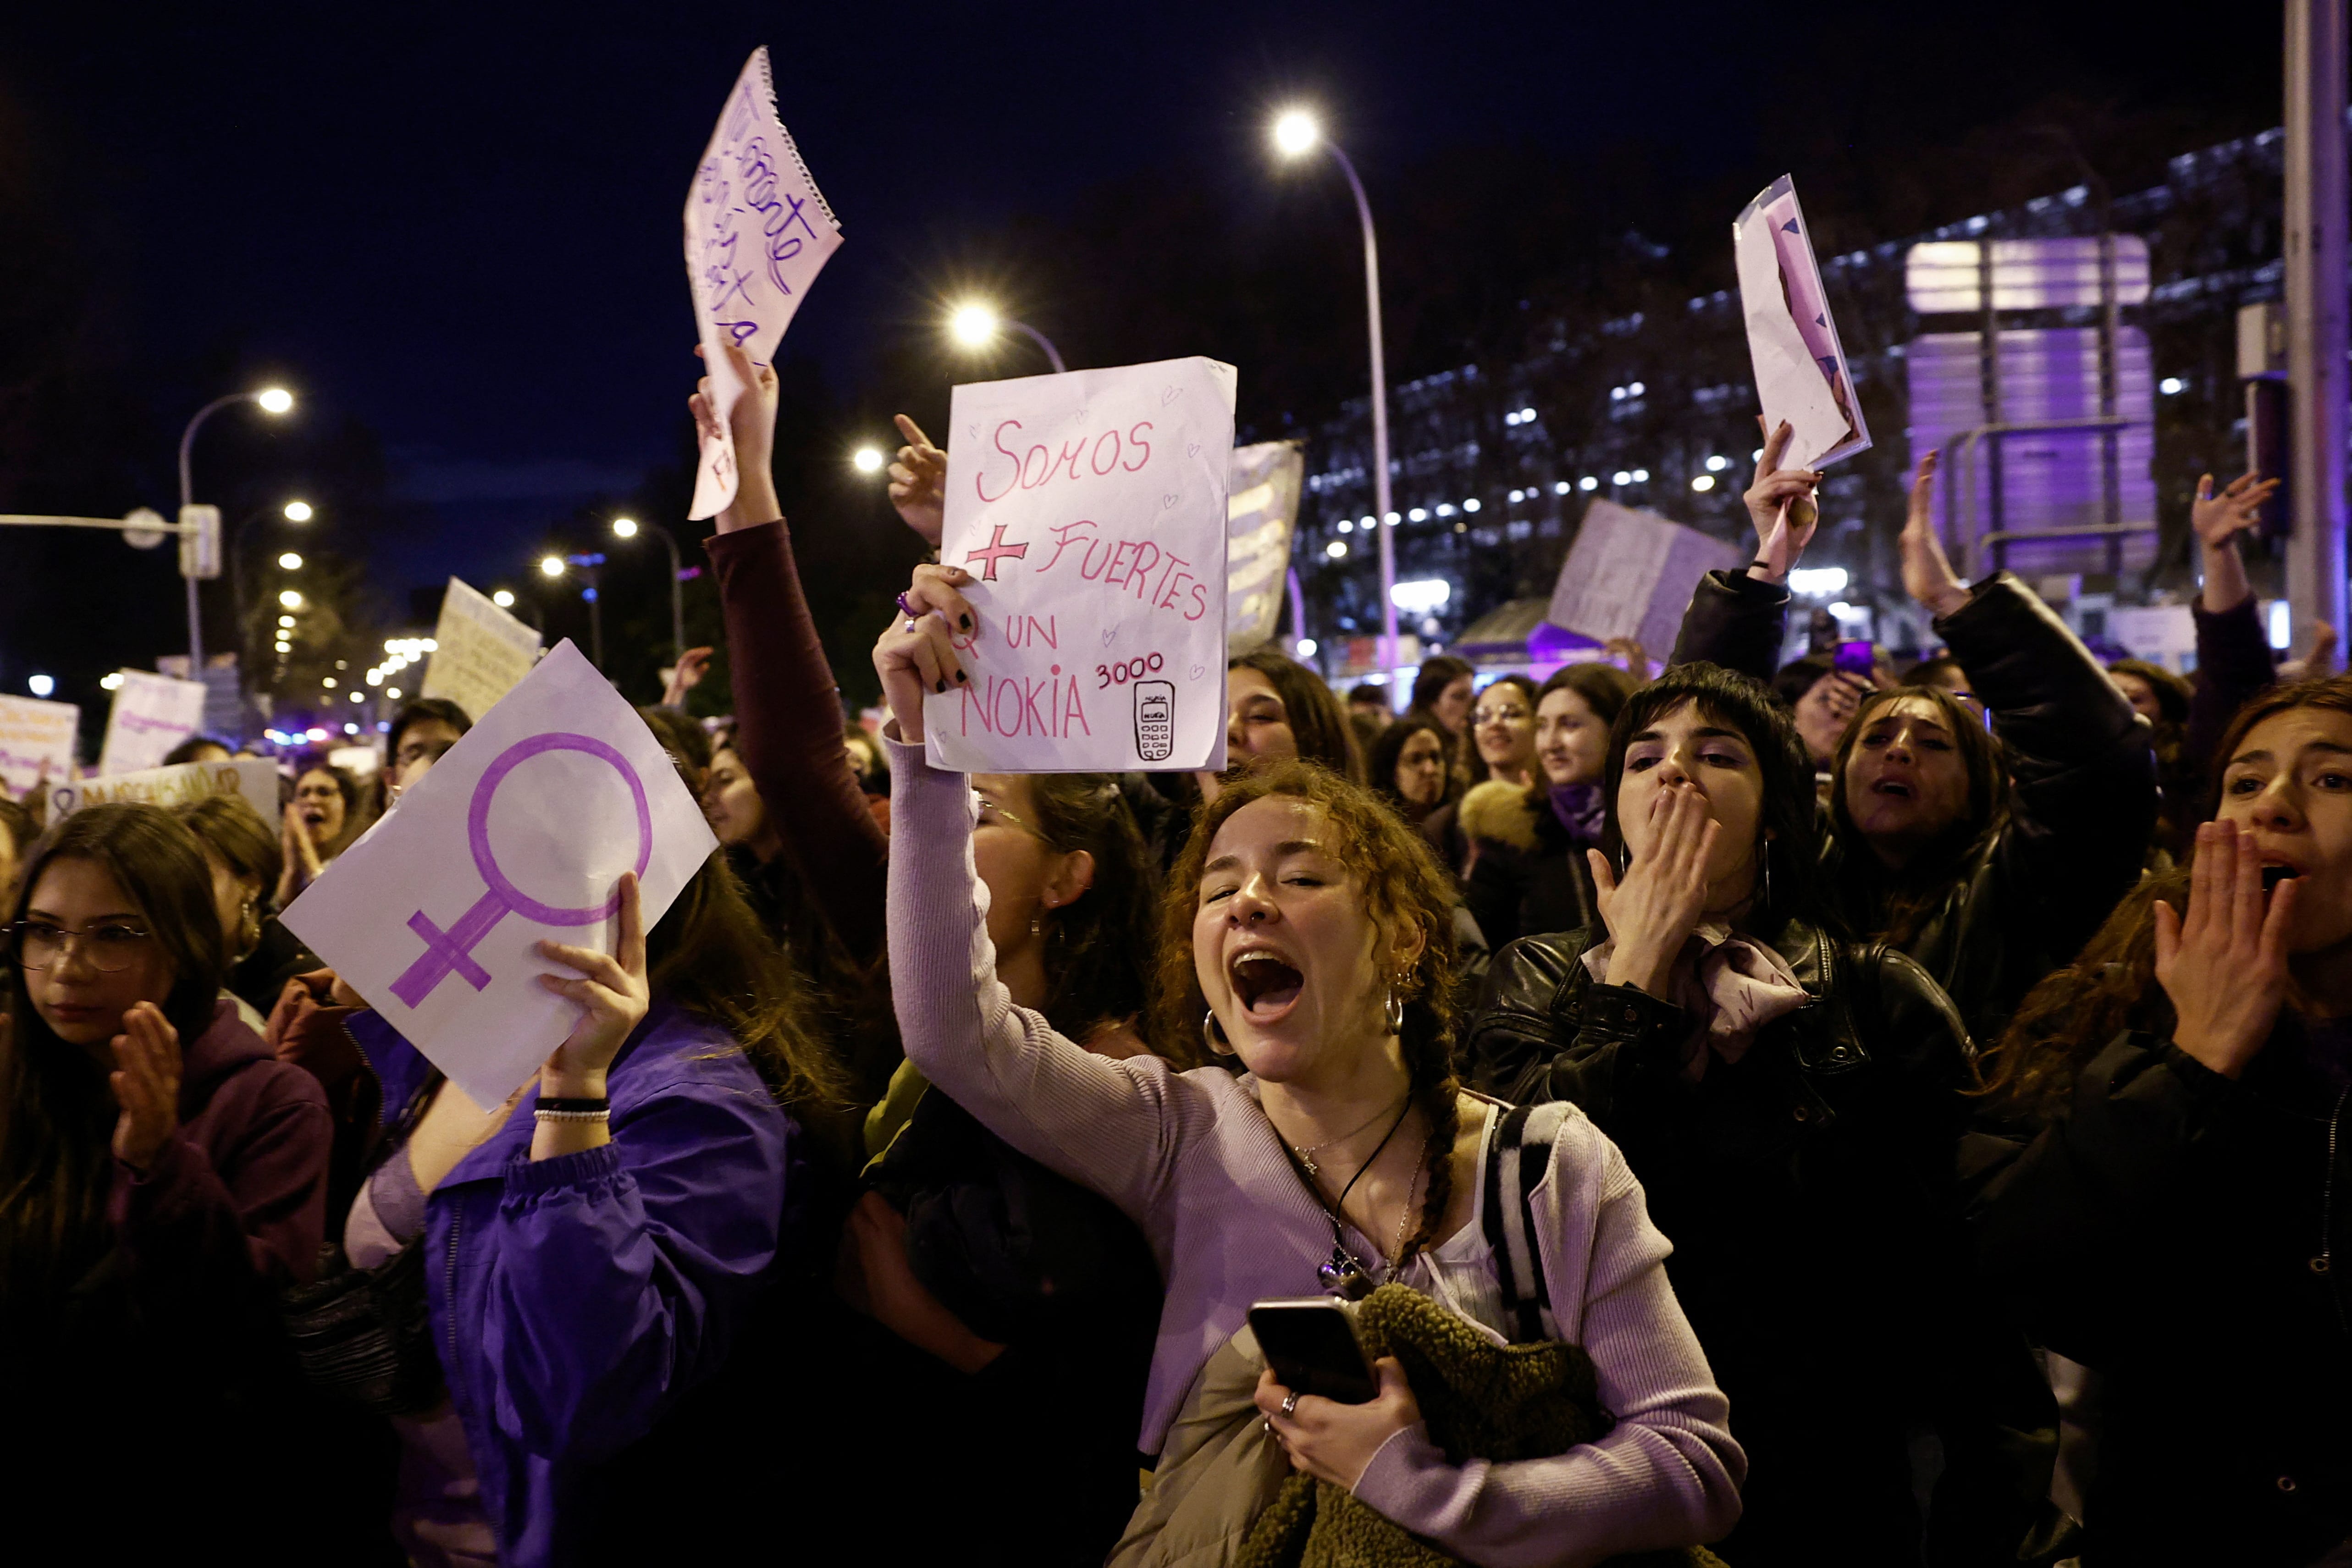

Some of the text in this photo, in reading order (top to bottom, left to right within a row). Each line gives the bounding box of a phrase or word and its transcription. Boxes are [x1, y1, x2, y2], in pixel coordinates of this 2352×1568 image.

[976, 420, 1154, 502] SOMOS
[1036, 520, 1207, 621] FUERTES
[1006, 615, 1057, 649] UN
[1095, 651, 1165, 690] 3000
